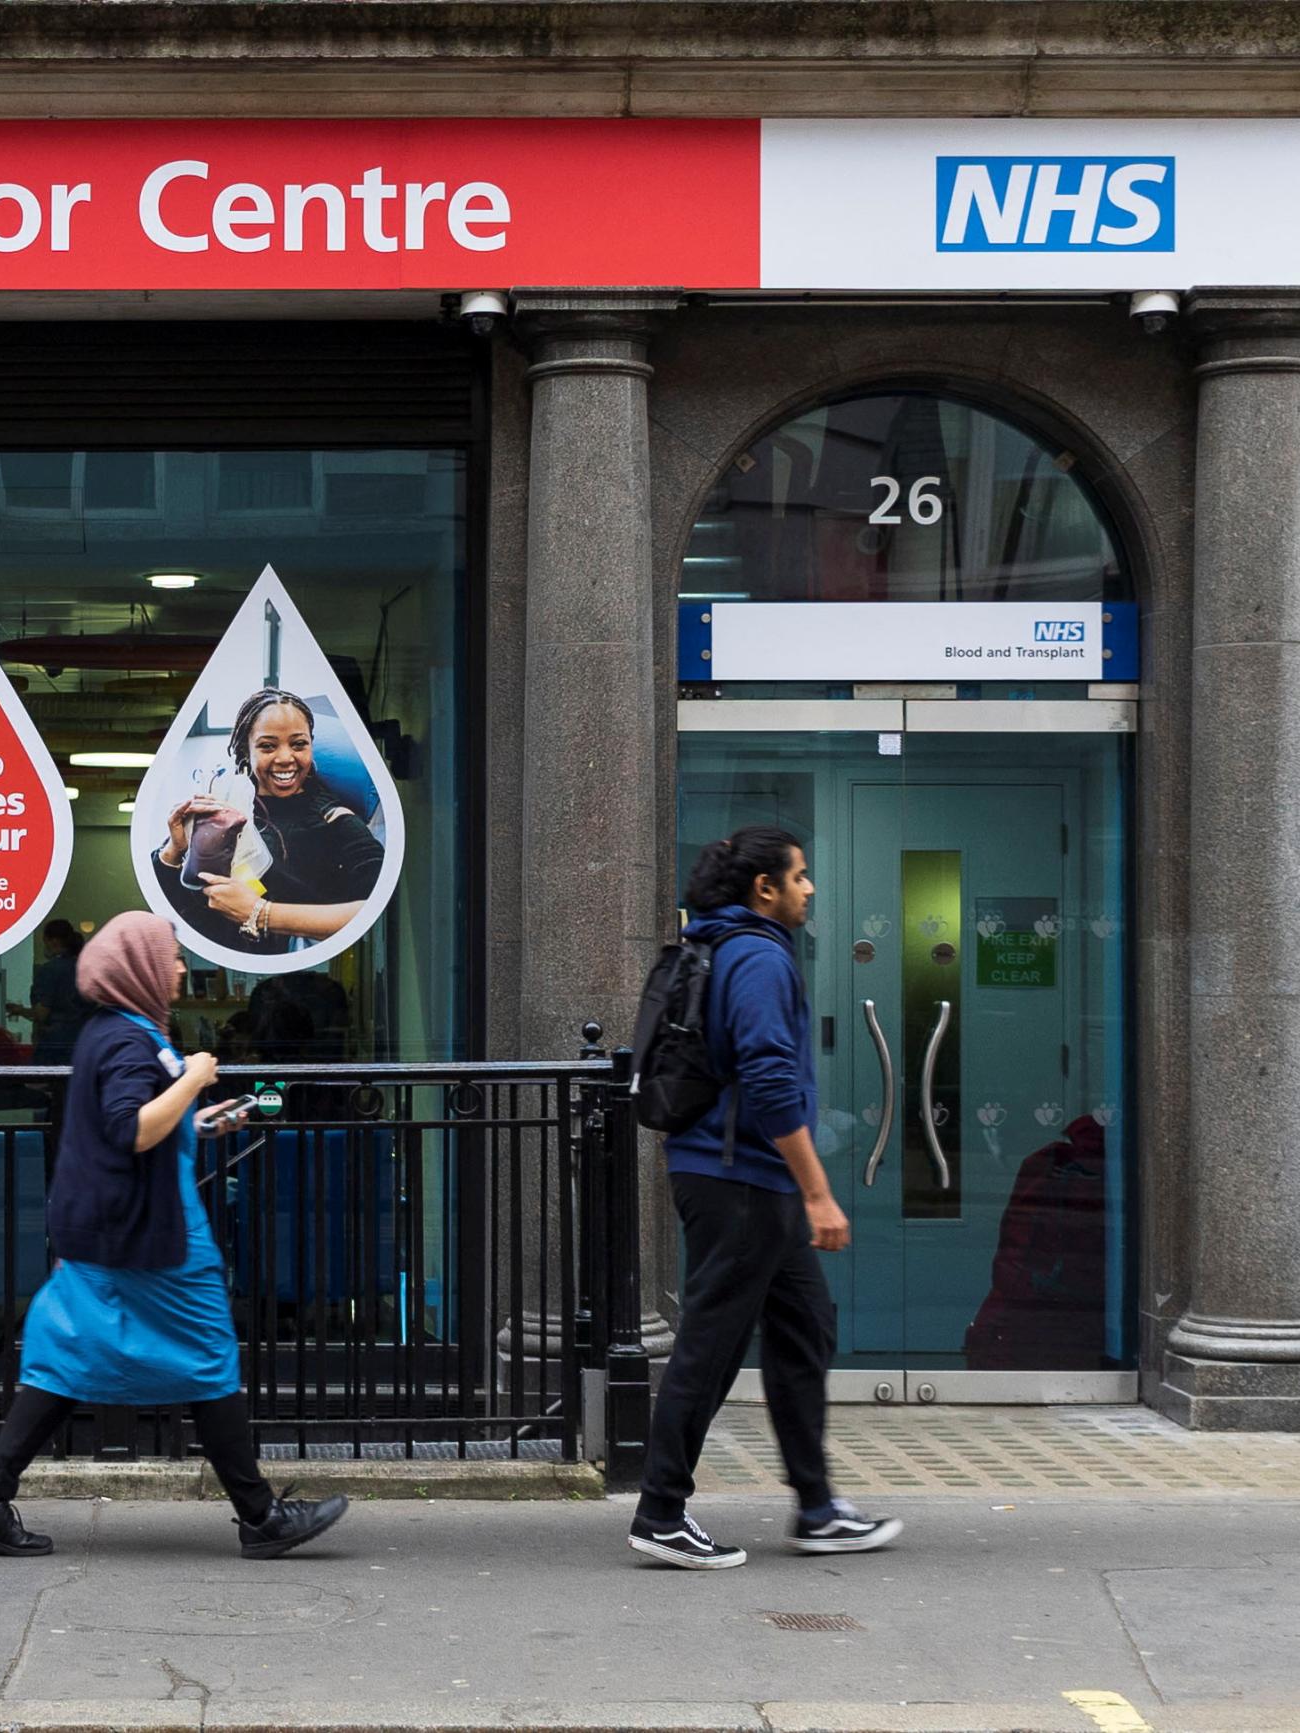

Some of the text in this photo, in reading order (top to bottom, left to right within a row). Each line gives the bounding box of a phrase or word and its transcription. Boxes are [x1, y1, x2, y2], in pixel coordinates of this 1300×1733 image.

[138, 159, 511, 253] Centre
[938, 157, 1174, 251] NHS
[868, 476, 943, 525] 26
[1035, 622, 1084, 641] NHS
[945, 646, 1085, 660] Blood and Transplant
[995, 951, 1036, 965] KEEP
[990, 969, 1041, 983] CLEAR
